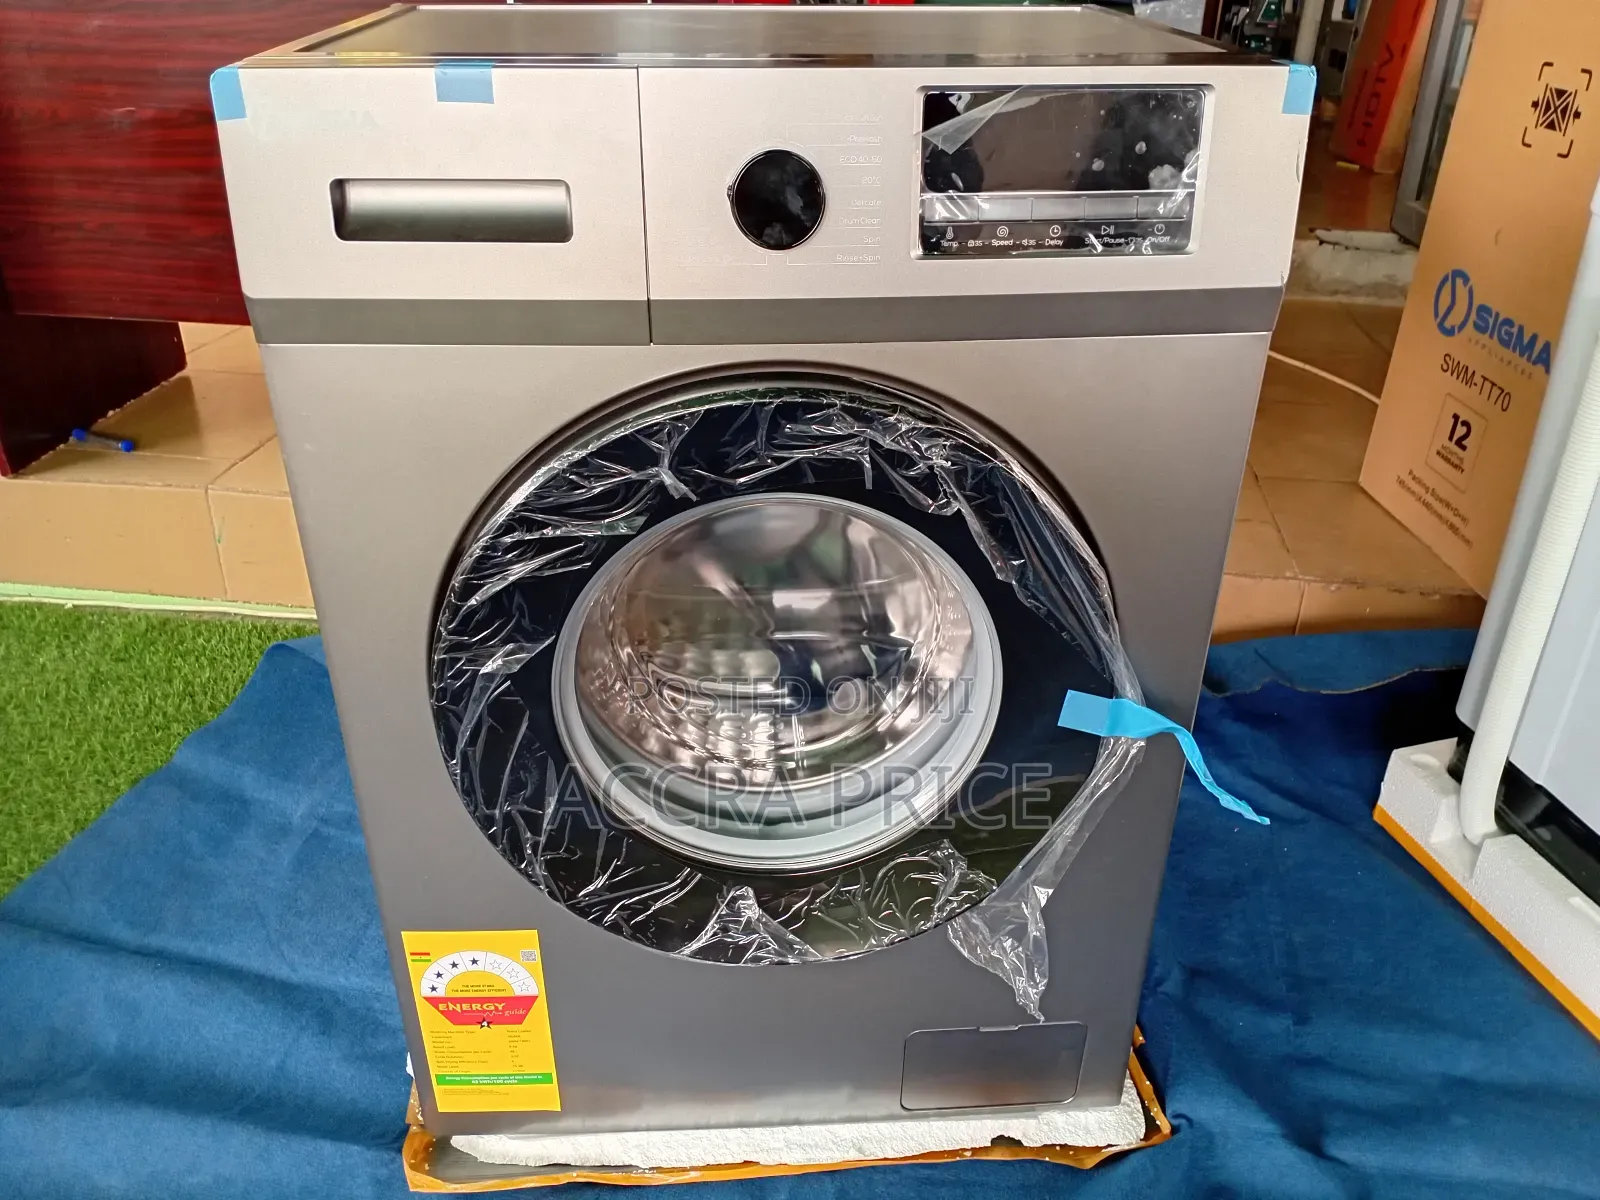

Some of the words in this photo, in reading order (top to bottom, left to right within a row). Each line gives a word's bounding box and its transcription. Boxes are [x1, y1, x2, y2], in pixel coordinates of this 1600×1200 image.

[840, 155, 857, 163] ECO
[861, 216, 881, 224] Clean
[863, 235, 881, 243] Spin
[1045, 238, 1063, 246] Delay
[836, 253, 881, 262] Rinse+Spin
[1473, 303, 1551, 376] SIGMA
[1440, 353, 1511, 412] SWM-TT70
[1447, 412, 1472, 452] 12
[438, 1001, 506, 1013] ENERGY
[504, 1008, 527, 1017] guide
